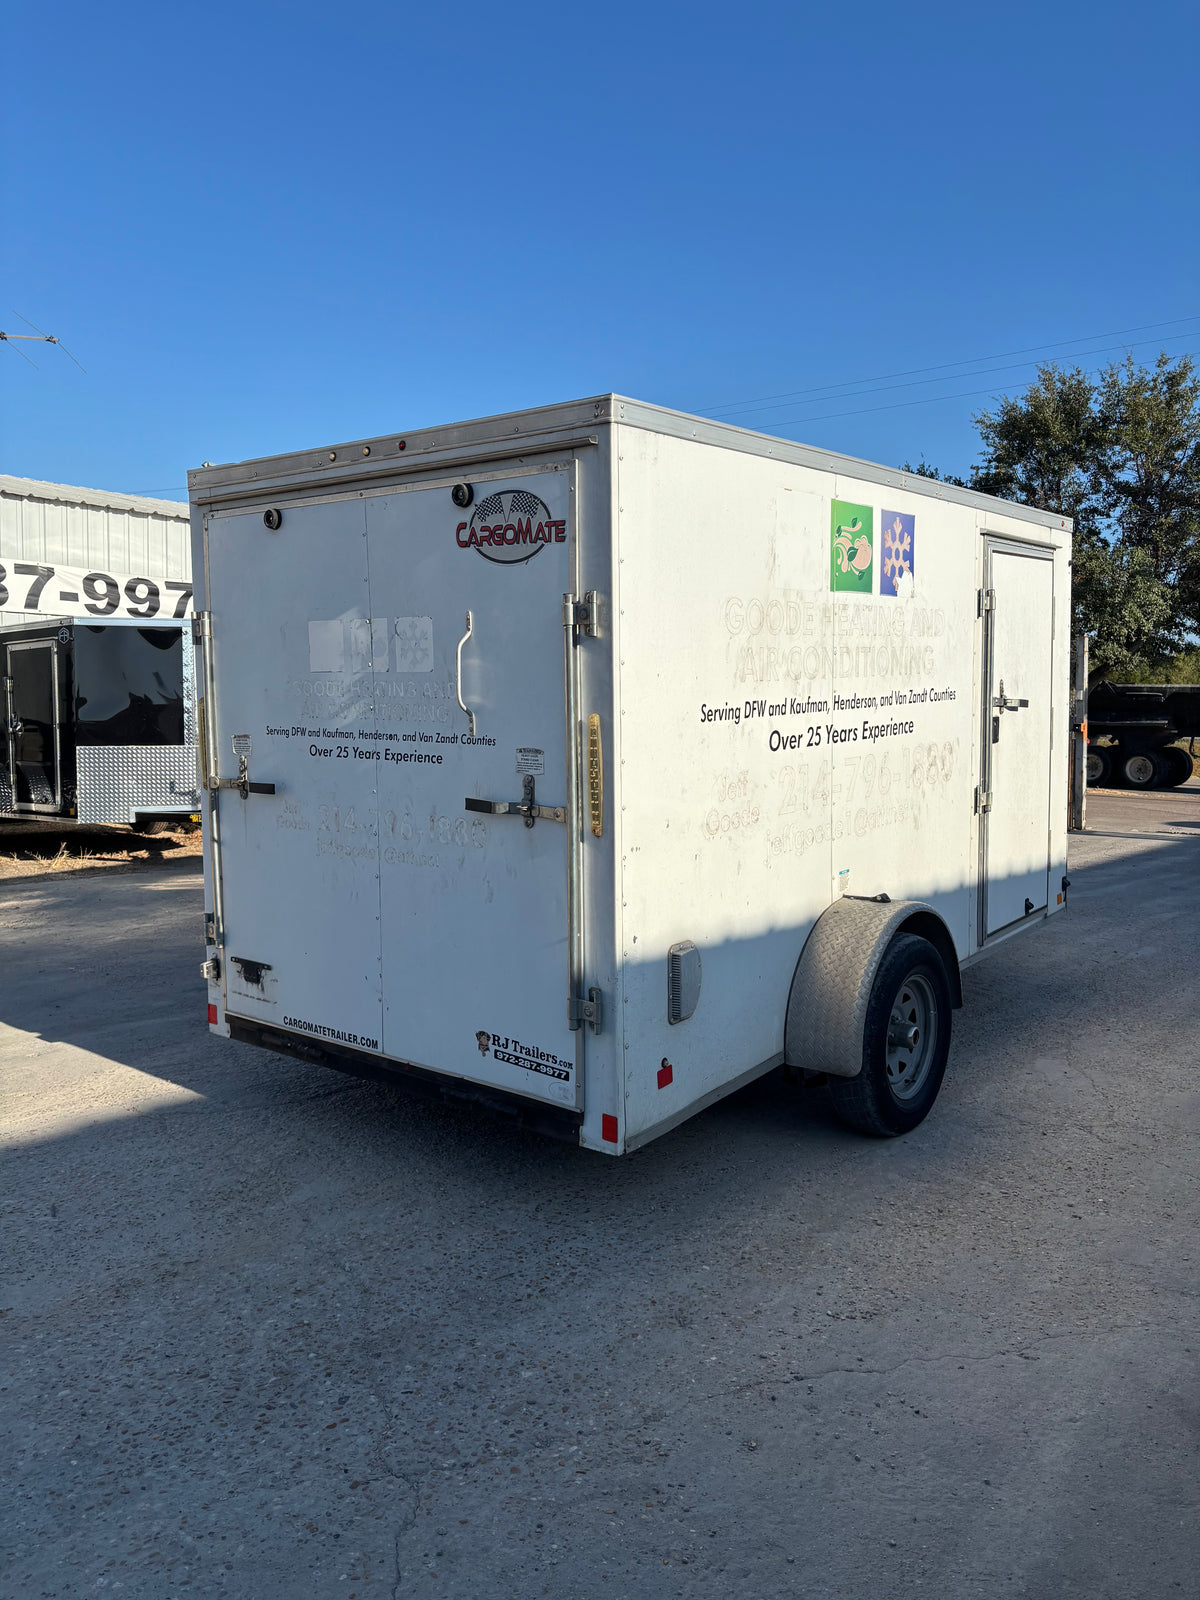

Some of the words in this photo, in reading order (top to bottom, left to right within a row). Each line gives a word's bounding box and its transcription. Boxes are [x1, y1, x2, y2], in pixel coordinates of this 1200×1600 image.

[0, 562, 193, 618] 7-997
[700, 701, 741, 725] Serving
[744, 699, 767, 718] DFW
[768, 697, 787, 716] and
[789, 695, 830, 715] Kaufman,
[832, 692, 878, 711] Henderson,
[880, 690, 893, 707] and
[894, 690, 907, 705] Van
[908, 688, 928, 704] Zandt
[929, 686, 956, 702] Counties
[266, 725, 290, 739] Serving
[291, 726, 307, 737] DFW
[308, 728, 320, 738] and
[322, 728, 356, 740] Kaufman,
[358, 729, 400, 743] Henderson,
[402, 731, 417, 742] and
[418, 732, 433, 743] Van
[435, 732, 458, 744] Zandt
[460, 734, 497, 746] Counties
[769, 730, 803, 752] Over
[806, 726, 822, 747] 25
[825, 724, 858, 745] Years
[862, 717, 914, 744] Experience
[309, 744, 333, 757] Over
[336, 745, 349, 759] 25
[352, 747, 381, 761] Years
[384, 748, 443, 765] Experience
[283, 1015, 379, 1050] CARGOMATETRAILER.COM
[491, 1033, 510, 1050] RJ
[496, 1051, 567, 1079] 972-287-9977
